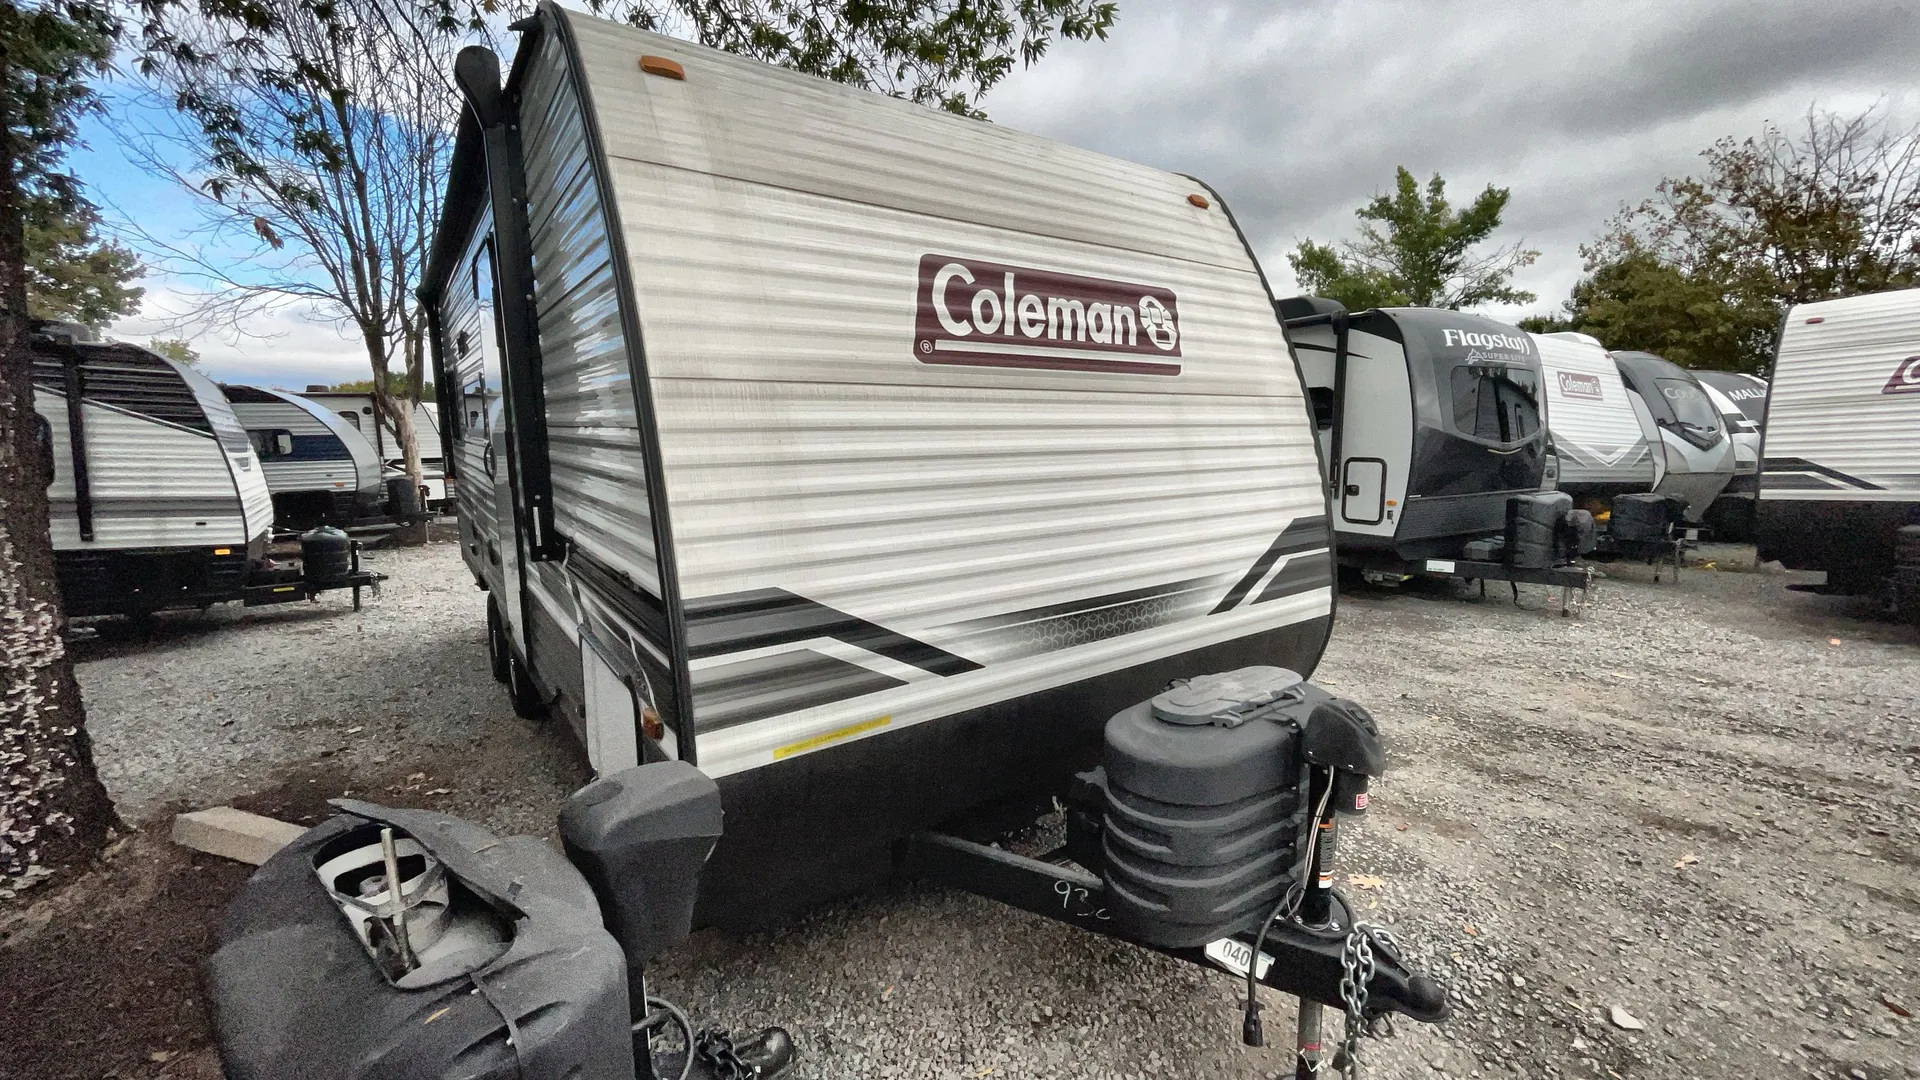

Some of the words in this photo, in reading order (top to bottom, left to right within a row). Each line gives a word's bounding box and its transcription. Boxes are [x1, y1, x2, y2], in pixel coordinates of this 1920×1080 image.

[932, 263, 1137, 346] Coleman
[1442, 329, 1530, 355] Flagstaff
[1481, 352, 1510, 361] SUPER
[1560, 373, 1594, 394] Coleman
[1222, 941, 1251, 967] 040
